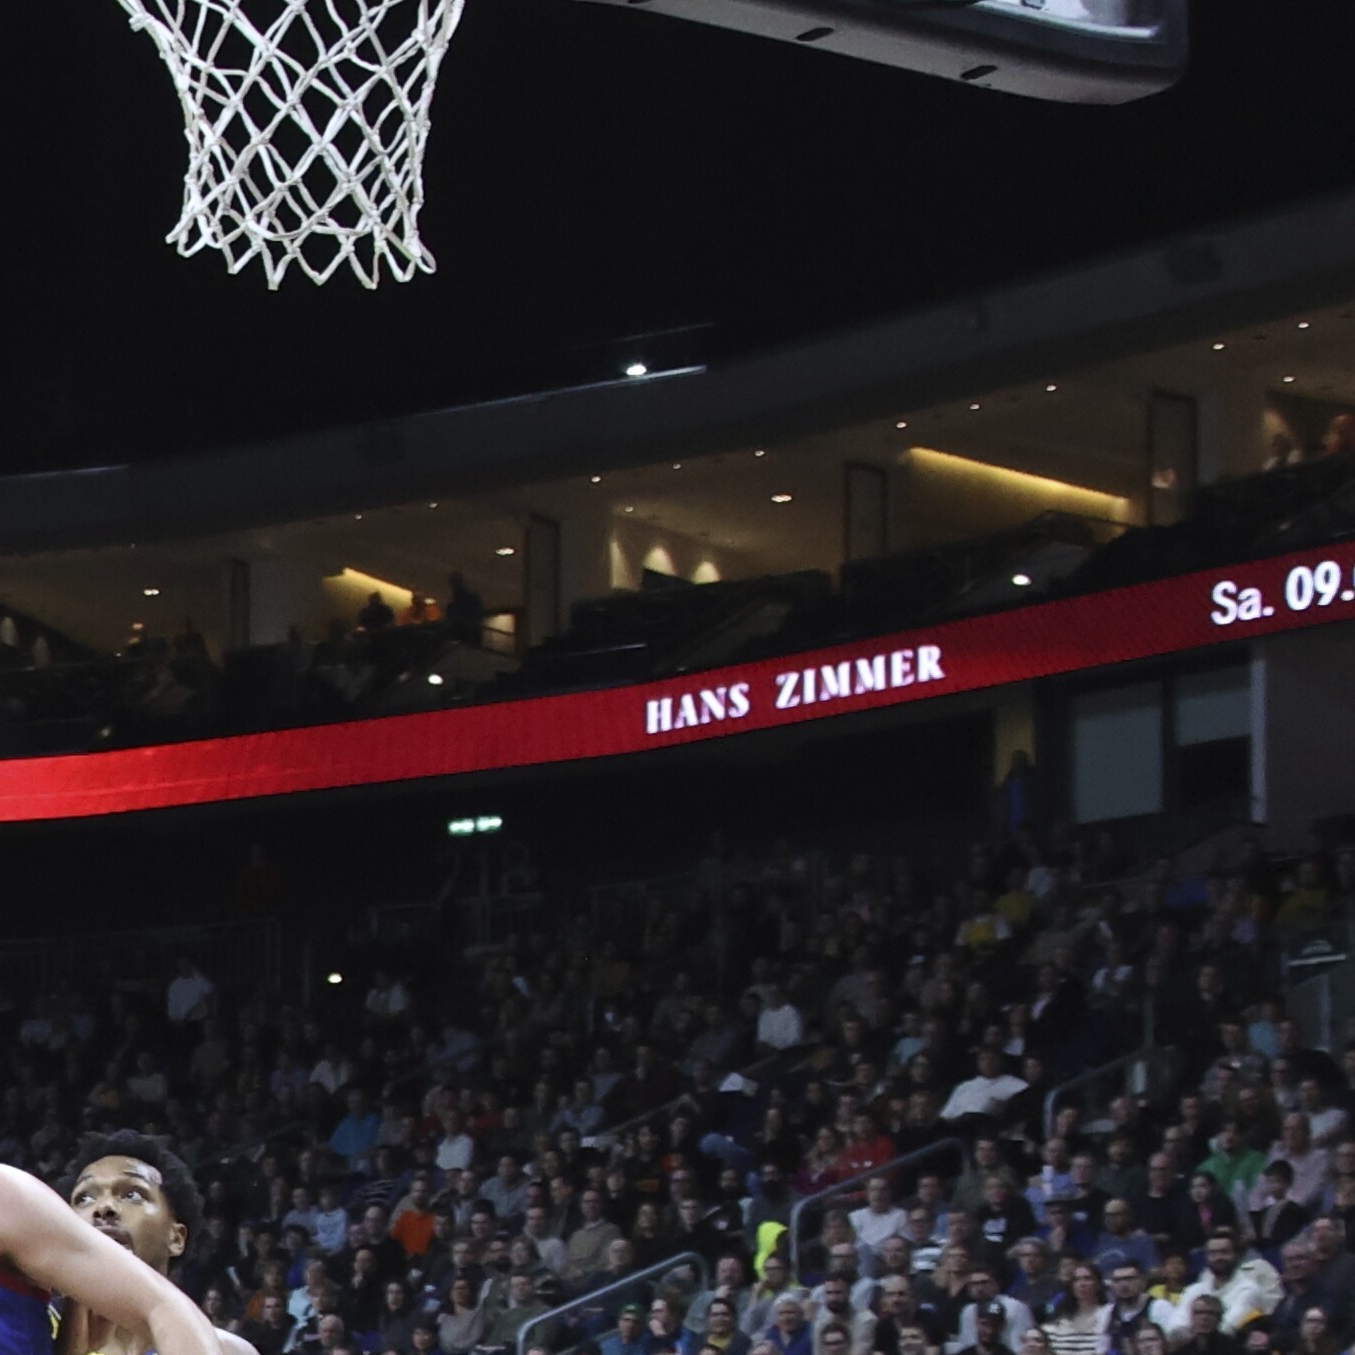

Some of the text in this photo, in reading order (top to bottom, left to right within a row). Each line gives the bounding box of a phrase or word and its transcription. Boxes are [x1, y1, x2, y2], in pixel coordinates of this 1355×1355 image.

[1210, 560, 1355, 625] Sa. 09.
[645, 644, 947, 734] HANS ZIMMER
